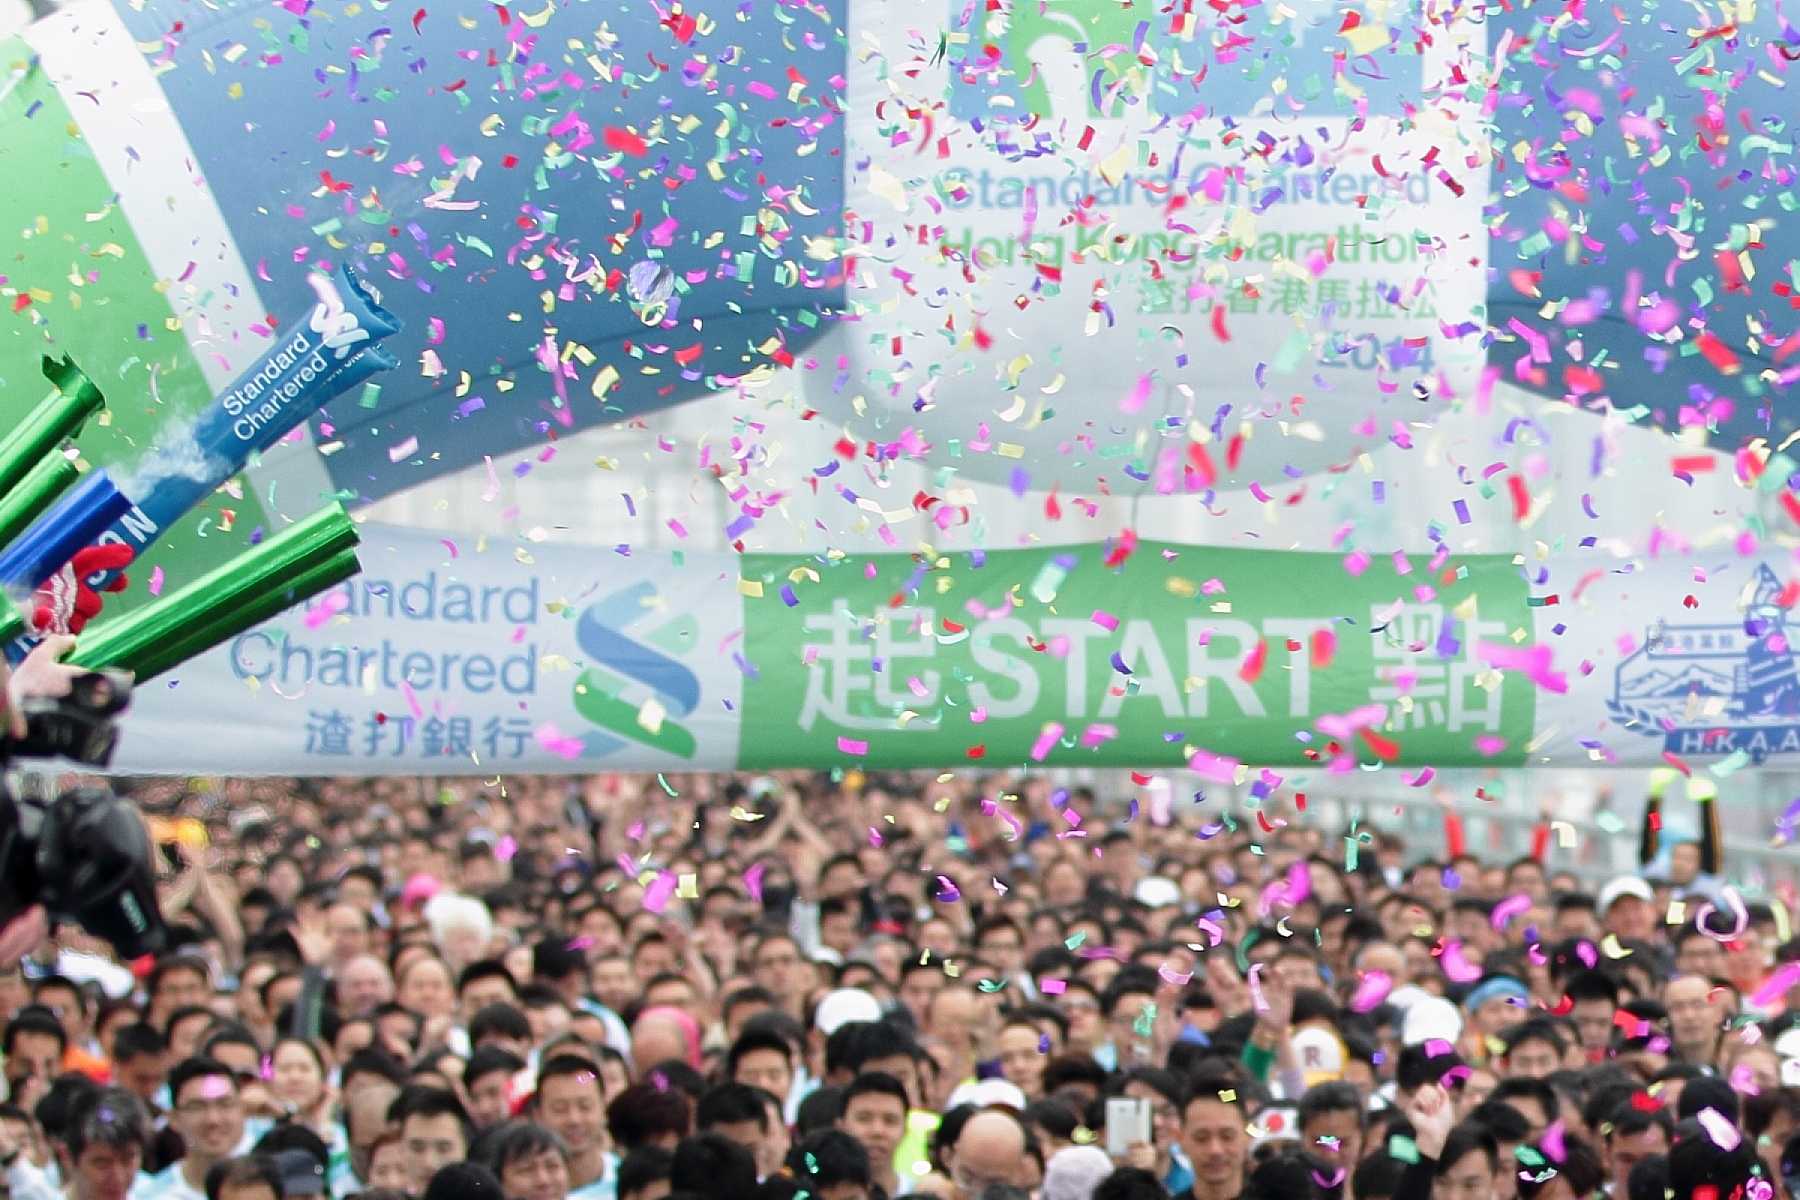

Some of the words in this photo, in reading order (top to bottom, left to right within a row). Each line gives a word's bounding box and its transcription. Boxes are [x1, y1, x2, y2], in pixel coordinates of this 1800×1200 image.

[944, 161, 1172, 209] Standard
[1190, 161, 1431, 208] Chartered
[940, 224, 1062, 270] Hong
[1075, 223, 1198, 270] Kong
[223, 332, 311, 416] Standard
[233, 350, 328, 441] Chartered
[229, 638, 538, 694] Chartered
[801, 597, 940, 732] 起
[968, 616, 1318, 719] START
[1370, 603, 1506, 733] 點
